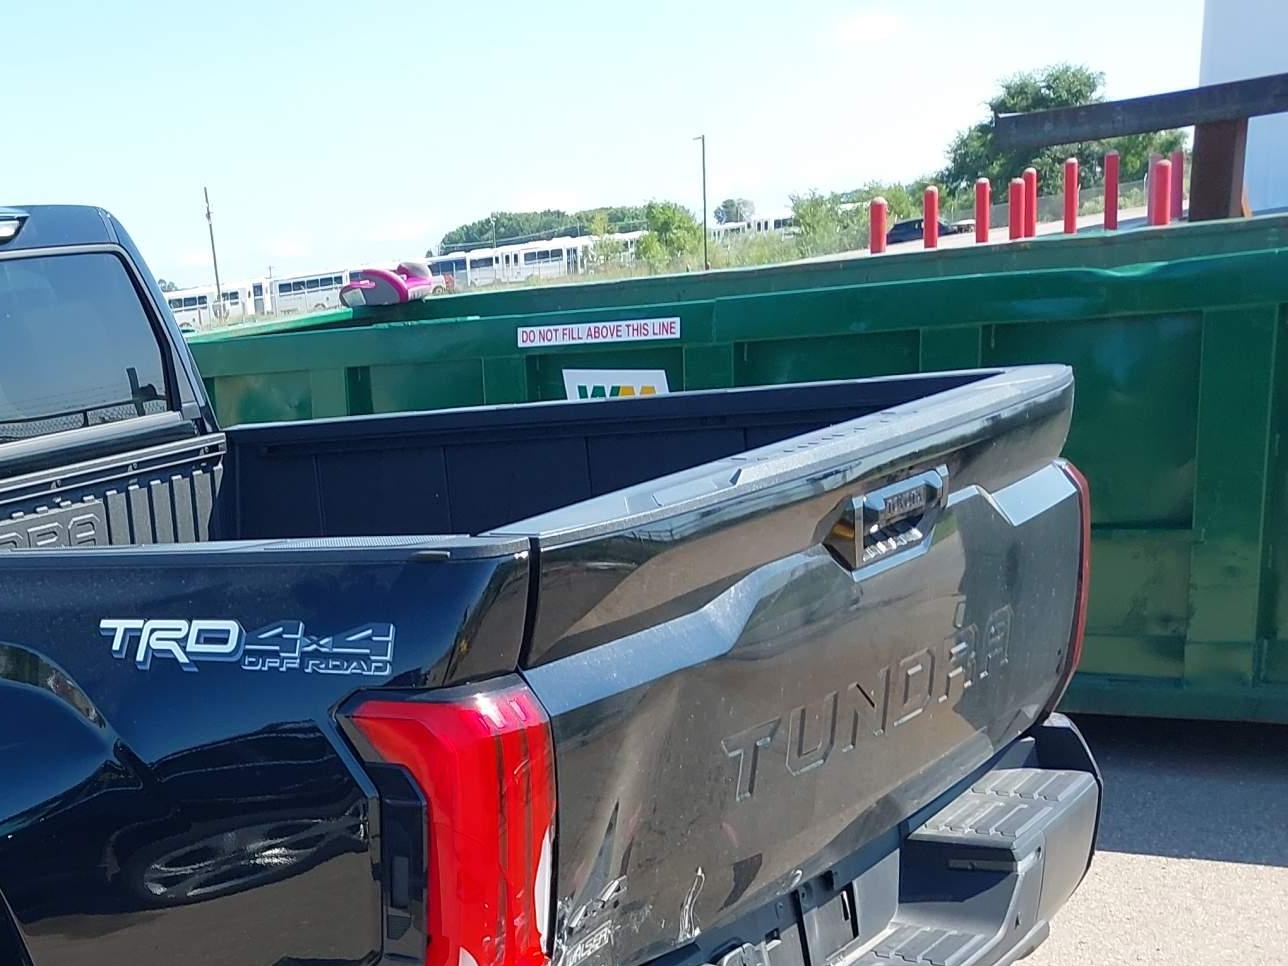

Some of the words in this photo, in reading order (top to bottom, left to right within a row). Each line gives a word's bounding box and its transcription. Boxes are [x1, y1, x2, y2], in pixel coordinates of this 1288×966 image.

[521, 329, 536, 343] DO
[538, 328, 559, 343] NOT
[562, 327, 583, 341] FILL
[586, 324, 622, 339] ABOVE
[625, 322, 649, 337] THIS
[652, 321, 677, 336] LINE
[99, 619, 245, 672] TRD
[240, 655, 300, 673] OFF
[305, 657, 393, 676] ROAD
[720, 603, 1015, 802] TUNDRA
